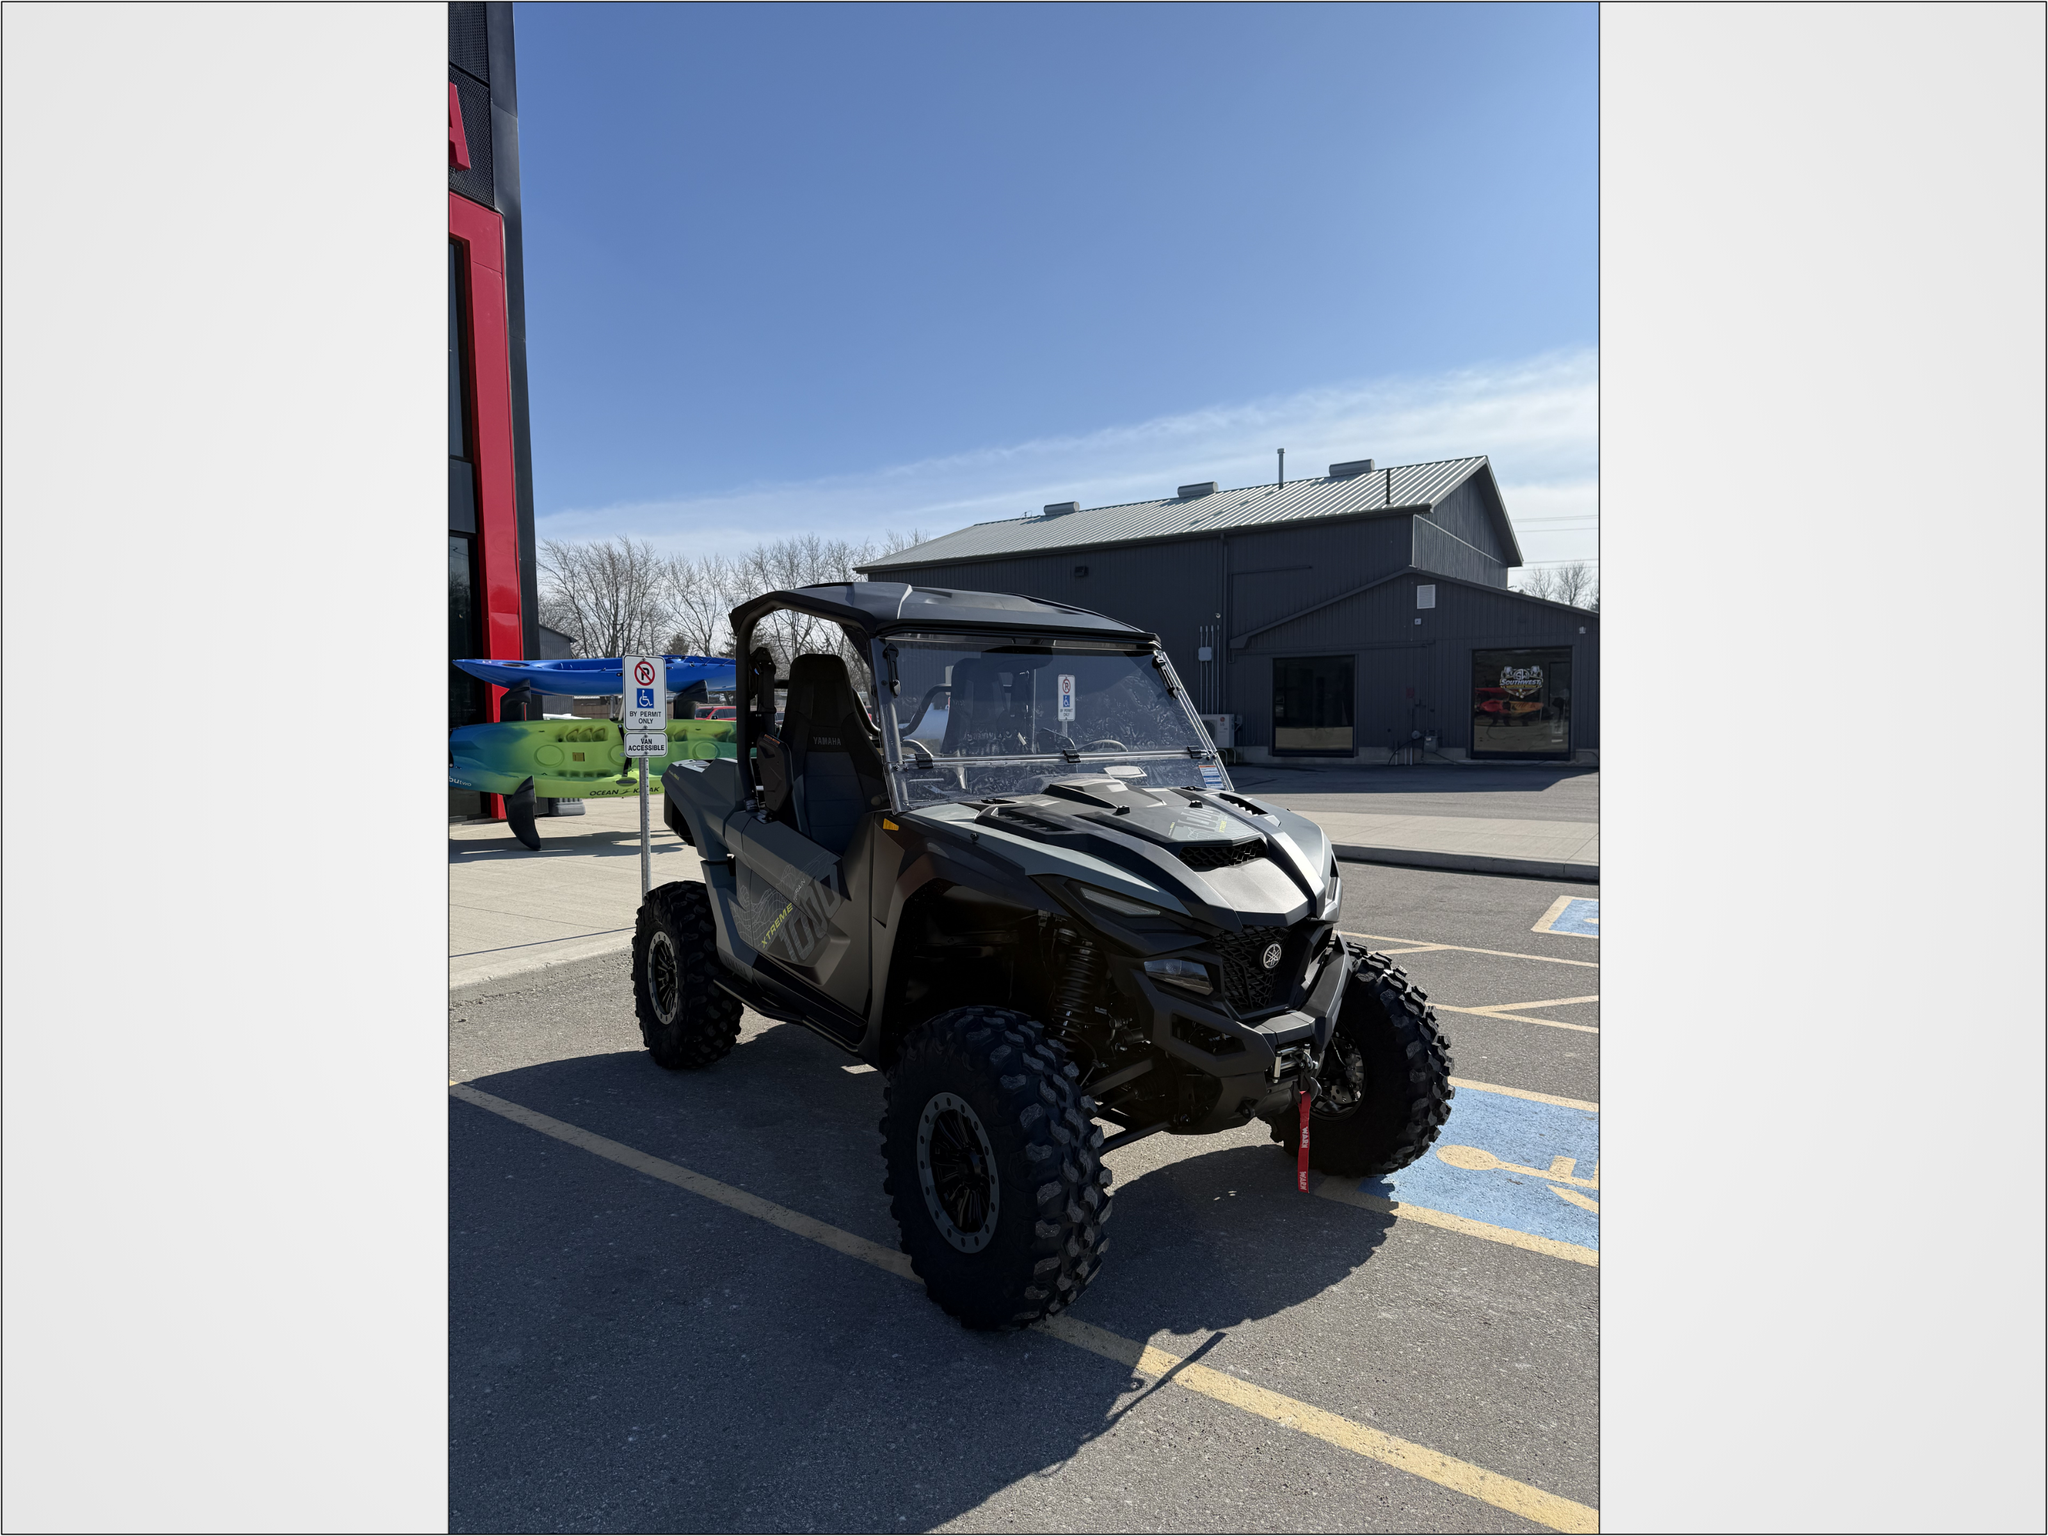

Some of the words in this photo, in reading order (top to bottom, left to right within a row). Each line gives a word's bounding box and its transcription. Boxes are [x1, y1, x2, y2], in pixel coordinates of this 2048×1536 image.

[1500, 678, 1541, 686] SOUTHWEST
[812, 736, 842, 746] YAMAHA
[632, 786, 660, 794] KAK
[778, 862, 846, 962] 1000
[761, 902, 793, 948] XTREME
[1301, 1126, 1309, 1149] WARN
[1299, 1171, 1307, 1191] WARN
